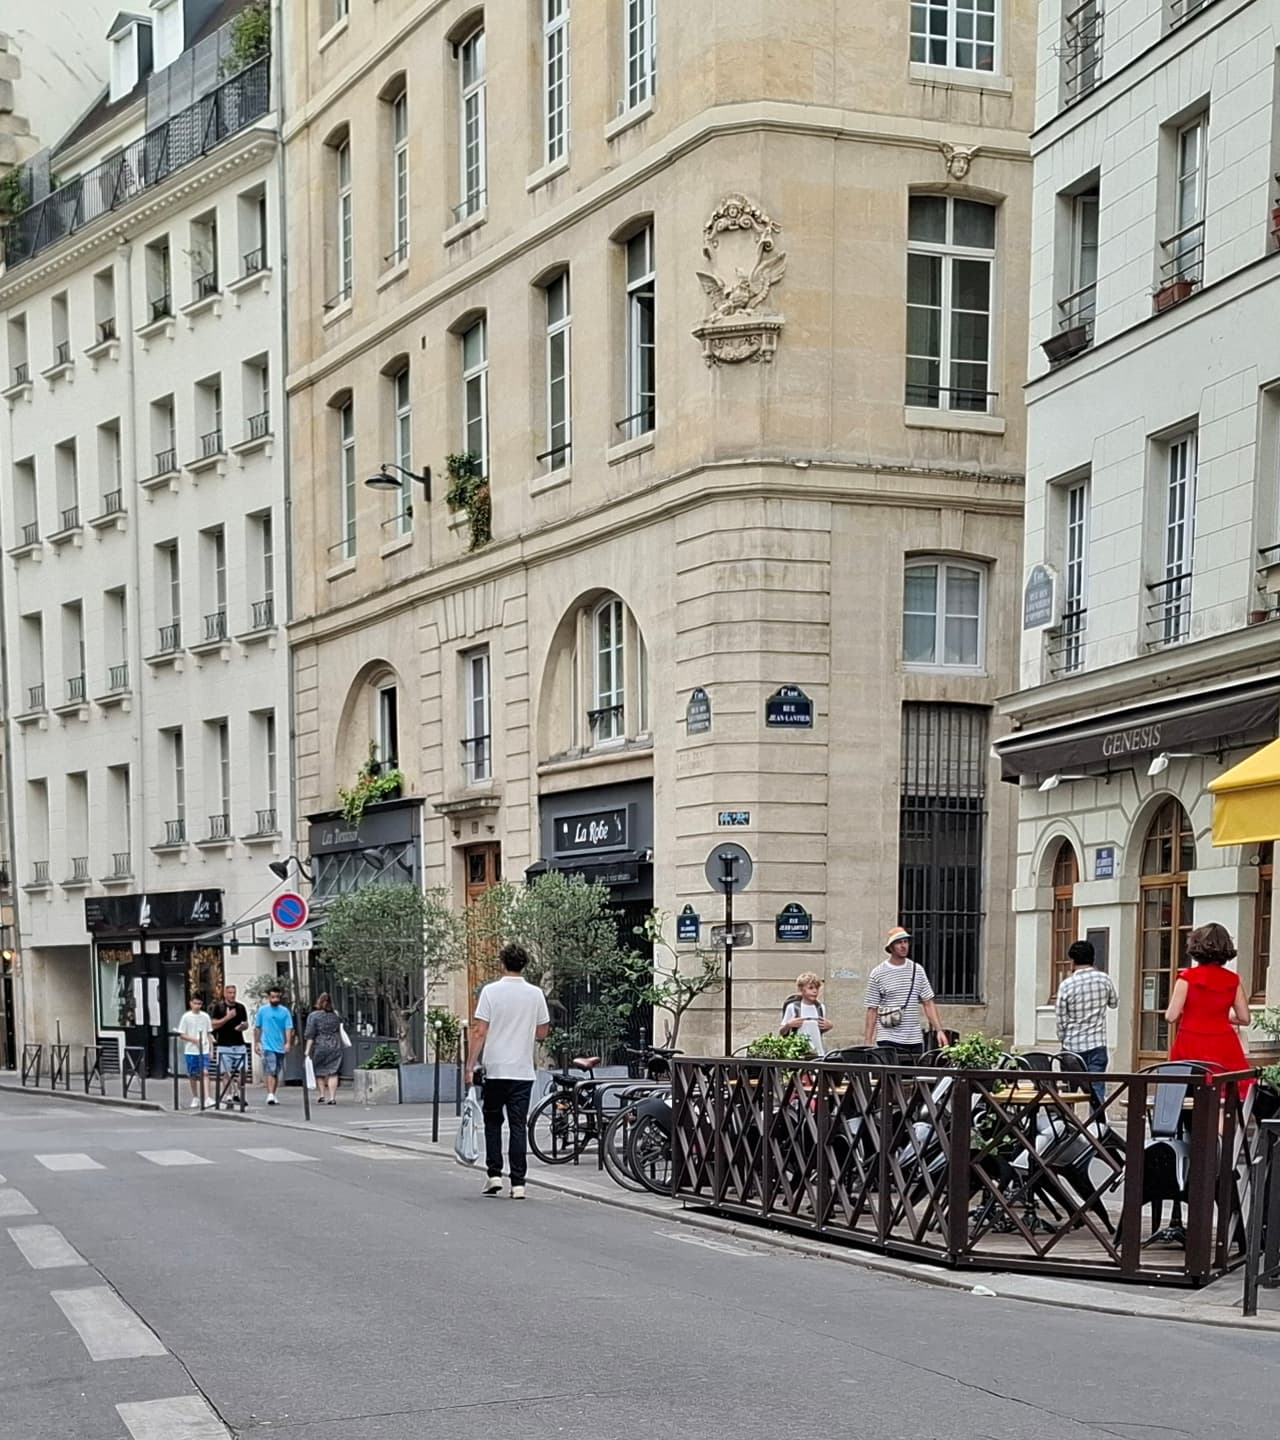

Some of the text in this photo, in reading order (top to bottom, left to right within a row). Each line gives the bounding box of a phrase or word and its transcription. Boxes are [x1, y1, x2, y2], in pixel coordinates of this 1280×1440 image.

[1102, 724, 1162, 757] GENESIS
[574, 820, 609, 845] La Robe
